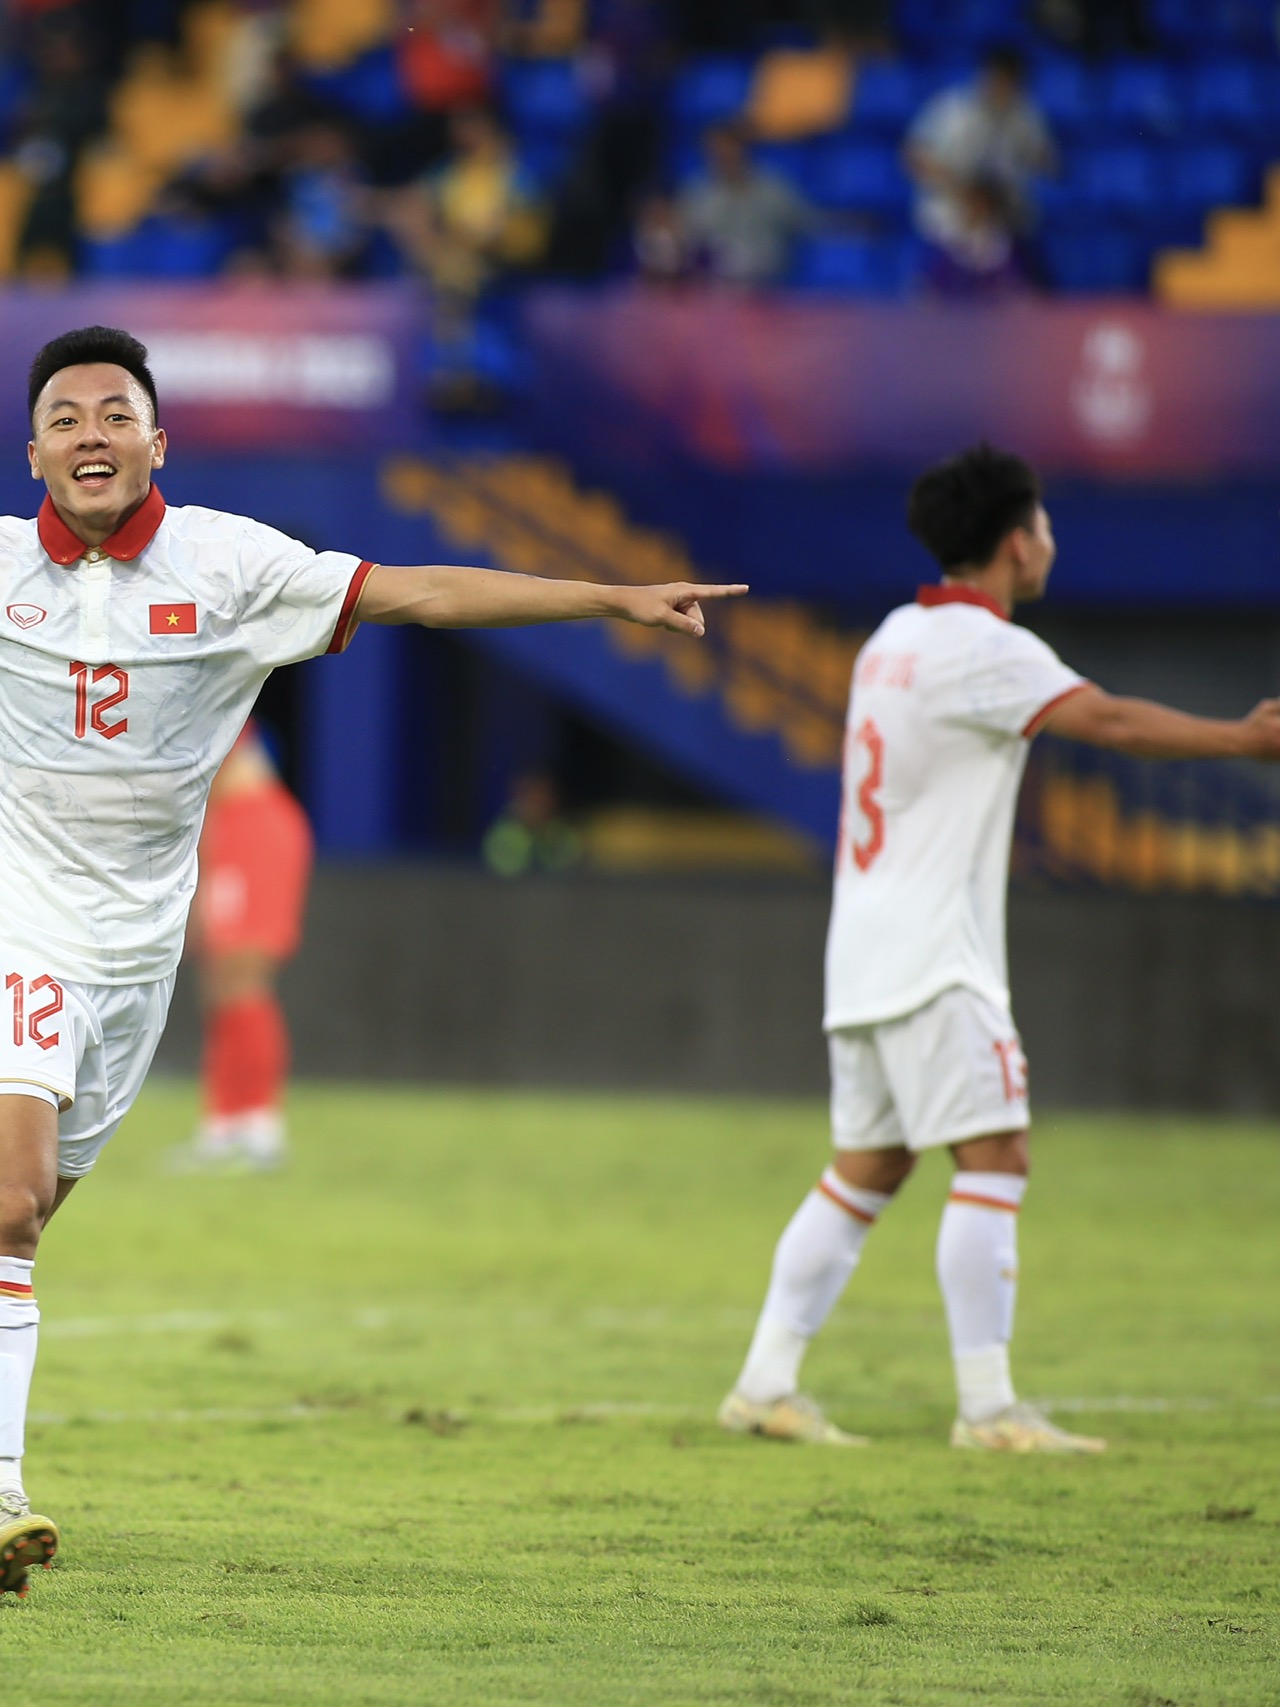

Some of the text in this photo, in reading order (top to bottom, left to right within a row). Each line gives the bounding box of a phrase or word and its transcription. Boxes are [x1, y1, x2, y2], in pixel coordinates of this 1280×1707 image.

[69, 660, 130, 740] 12
[835, 714, 886, 874] 3
[5, 971, 64, 1051] 12
